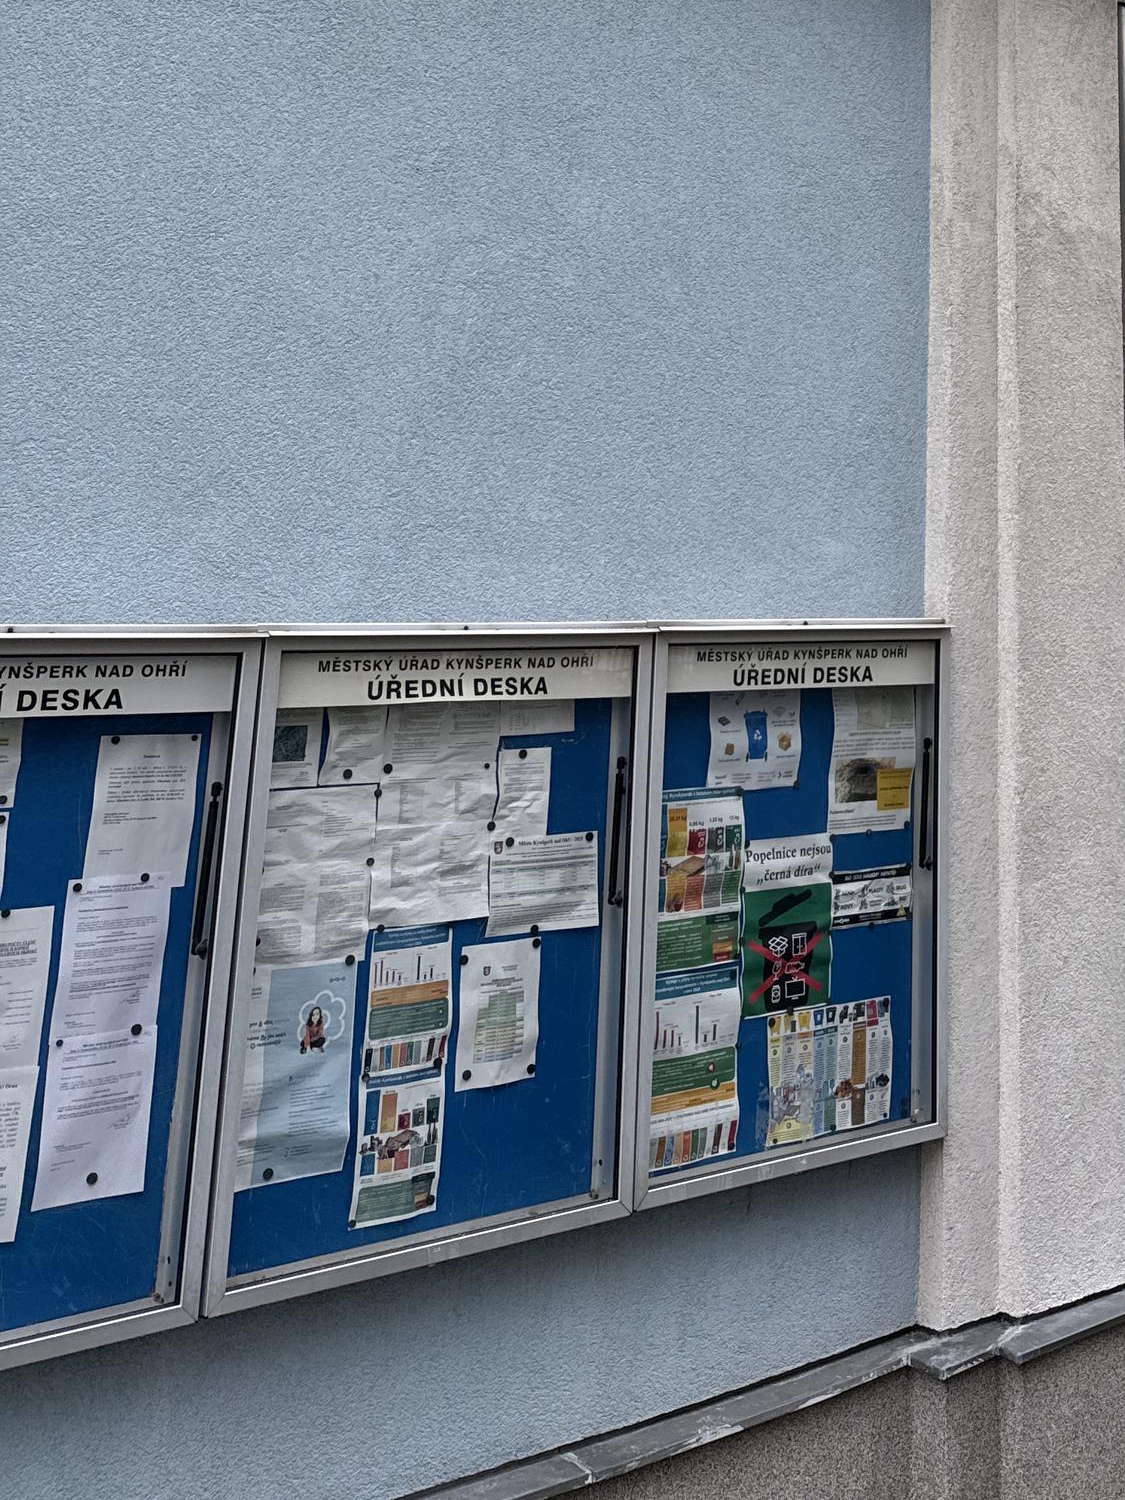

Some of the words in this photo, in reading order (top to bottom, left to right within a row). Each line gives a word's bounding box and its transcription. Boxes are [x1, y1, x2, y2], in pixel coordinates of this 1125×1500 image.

[317, 656, 394, 673] MĚSTSKÝ
[398, 656, 440, 671] ÚŘAD
[445, 654, 523, 670] KYNŠPERK
[527, 656, 556, 669] NAD
[560, 653, 595, 668] OHŘÍ
[757, 647, 789, 662] ÚŘAD
[793, 646, 853, 660] KYNŠPERK
[855, 648, 879, 660] NAD
[881, 645, 909, 659] OHŘÍ
[95, 664, 134, 679] NAD
[141, 659, 190, 678] OHŘÍ
[732, 663, 807, 687] ÚŘEDNÍ
[812, 665, 874, 685] DESKA
[367, 673, 465, 701] ÚŘEDNÍ
[473, 676, 549, 697] DESKA
[16, 688, 124, 712] DESKA
[745, 846, 797, 864] Popelnice
[800, 843, 832, 859] nejsou
